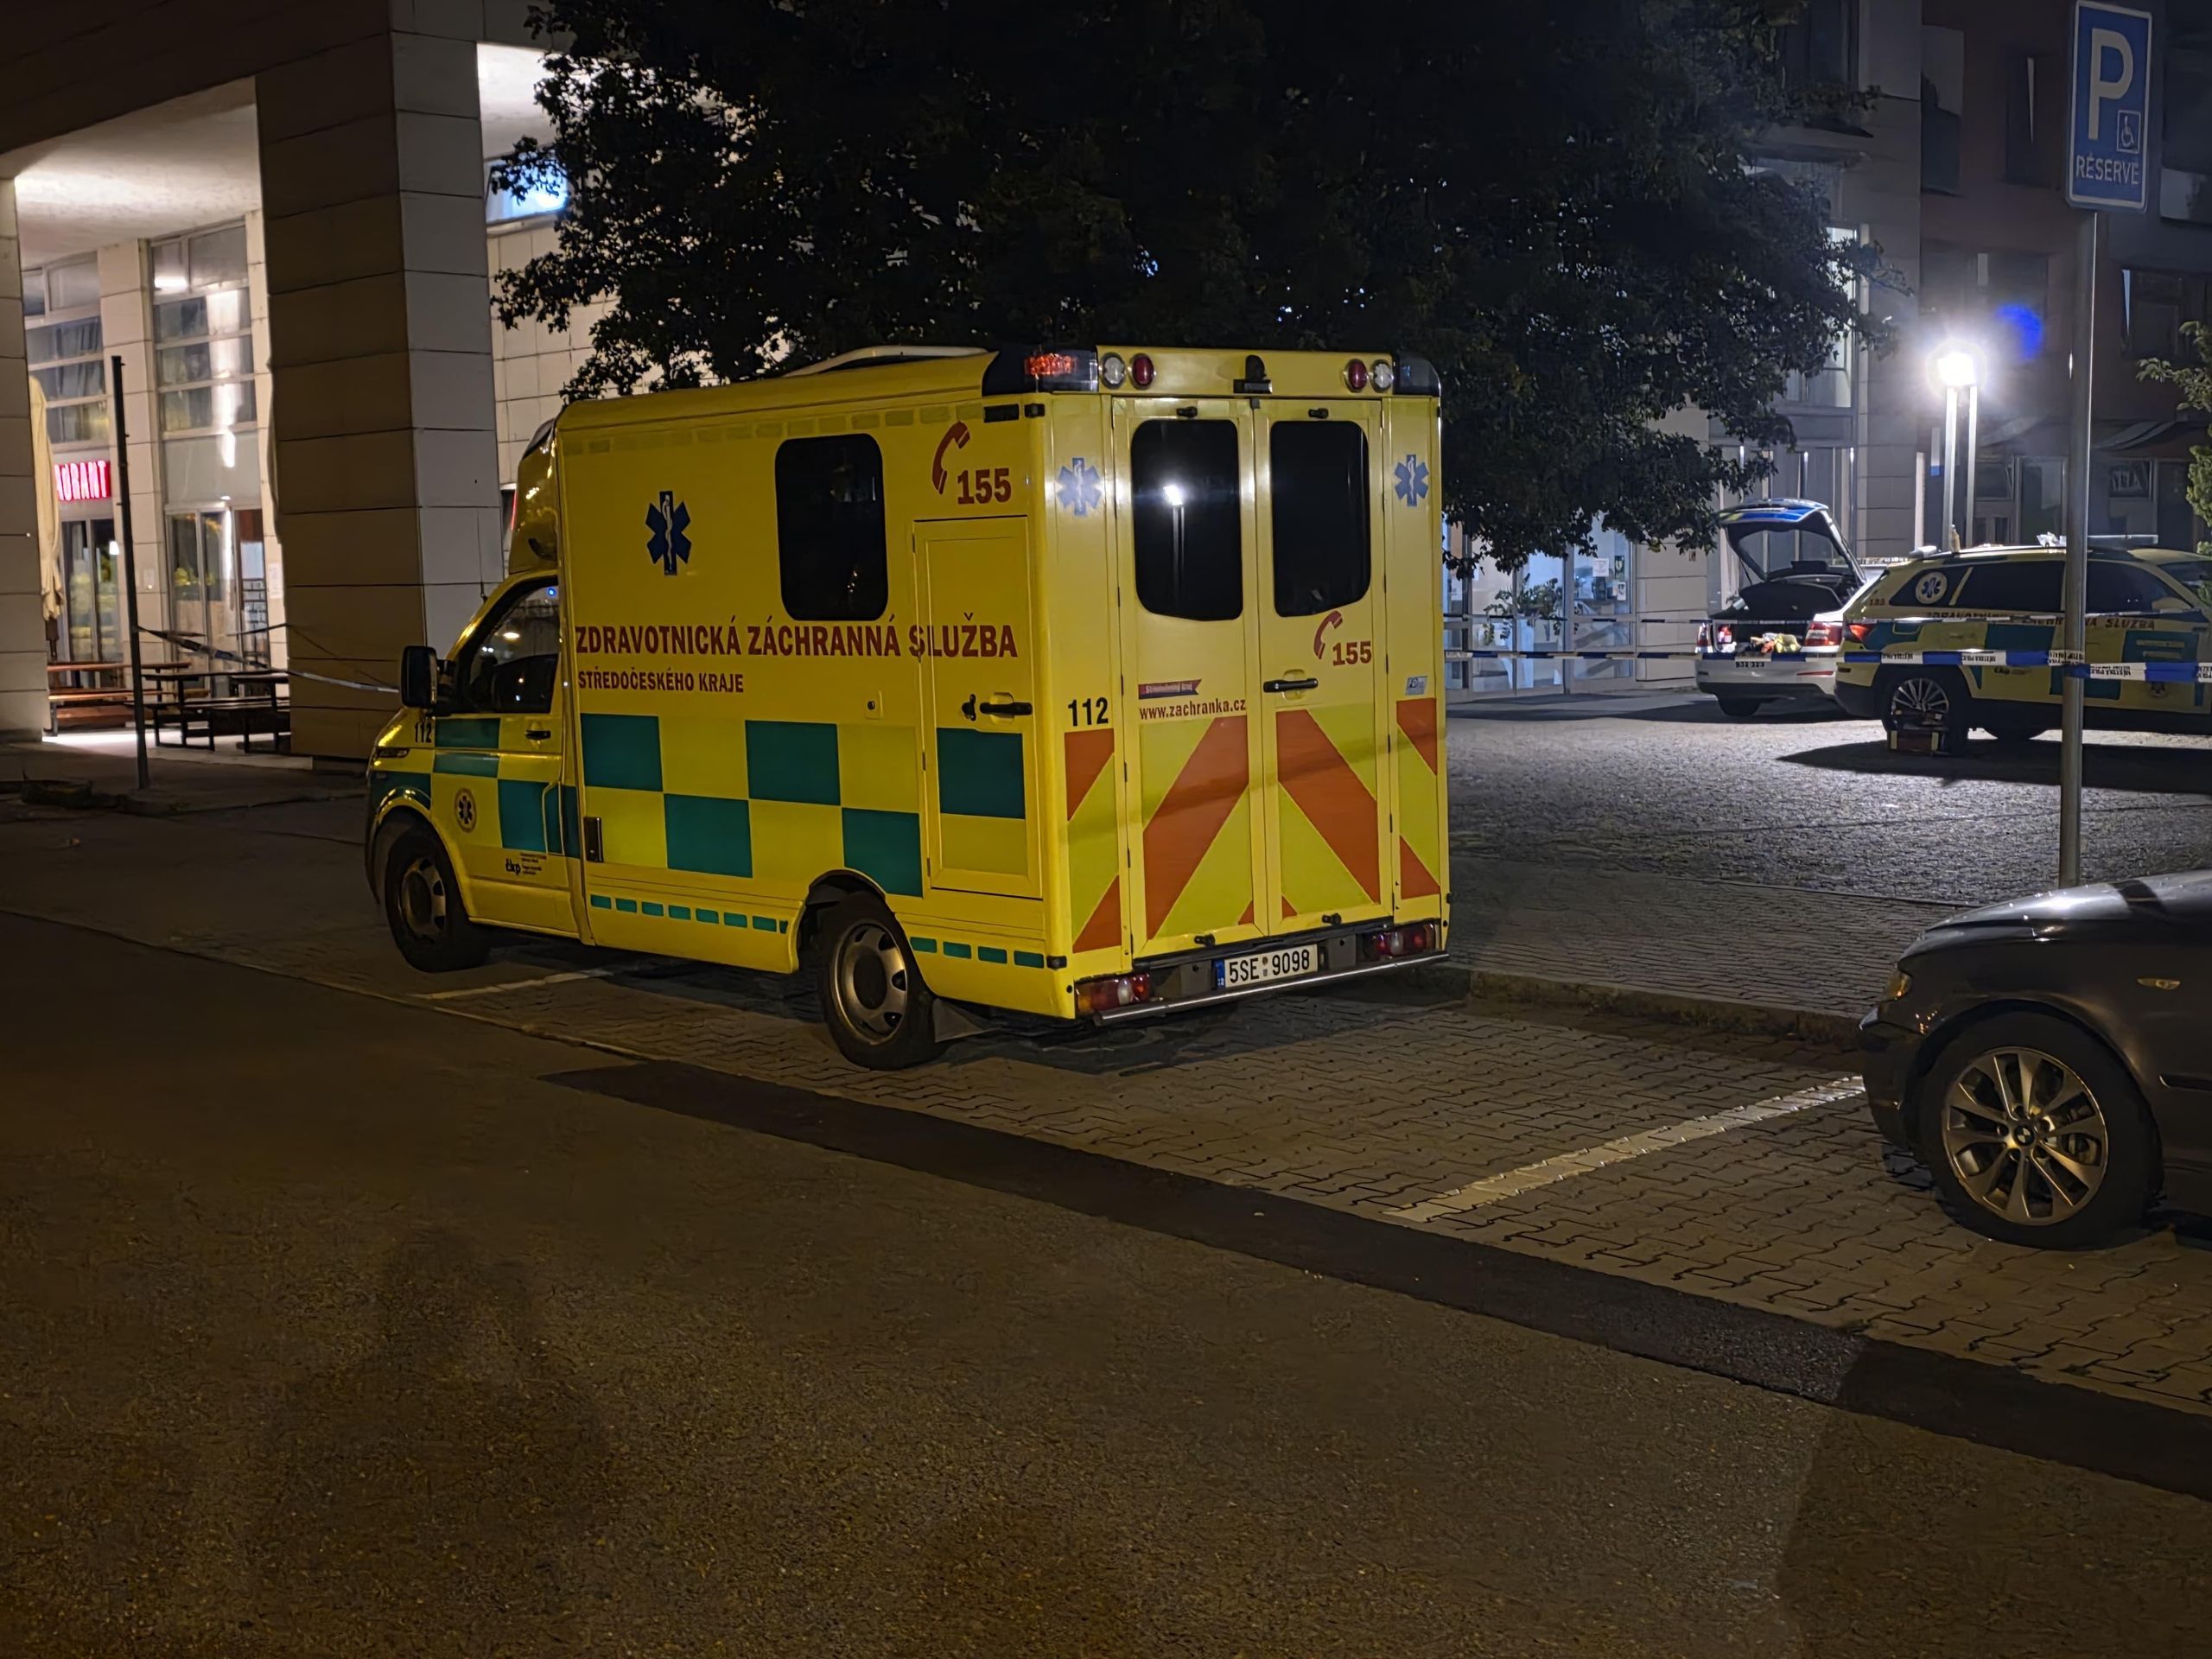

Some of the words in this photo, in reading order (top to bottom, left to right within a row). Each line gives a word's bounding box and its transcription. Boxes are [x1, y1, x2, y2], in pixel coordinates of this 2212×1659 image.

[2088, 28, 2134, 140] P
[957, 467, 1012, 505] 155
[575, 616, 741, 656] ZDRAVOTNICKÁ
[747, 615, 901, 658] ZÁCHRANNÁ
[908, 613, 1018, 658] SLUŽBA
[1332, 641, 1372, 665] 155
[577, 667, 694, 691] STŘEDOČESKÉHO
[698, 673, 744, 693] KRAJE
[1067, 697, 1109, 727] 112
[1139, 699, 1247, 720] www.zachranka.cz
[414, 722, 433, 743] 112
[1229, 957, 1260, 983] 5SE
[1272, 949, 1310, 976] 9098
